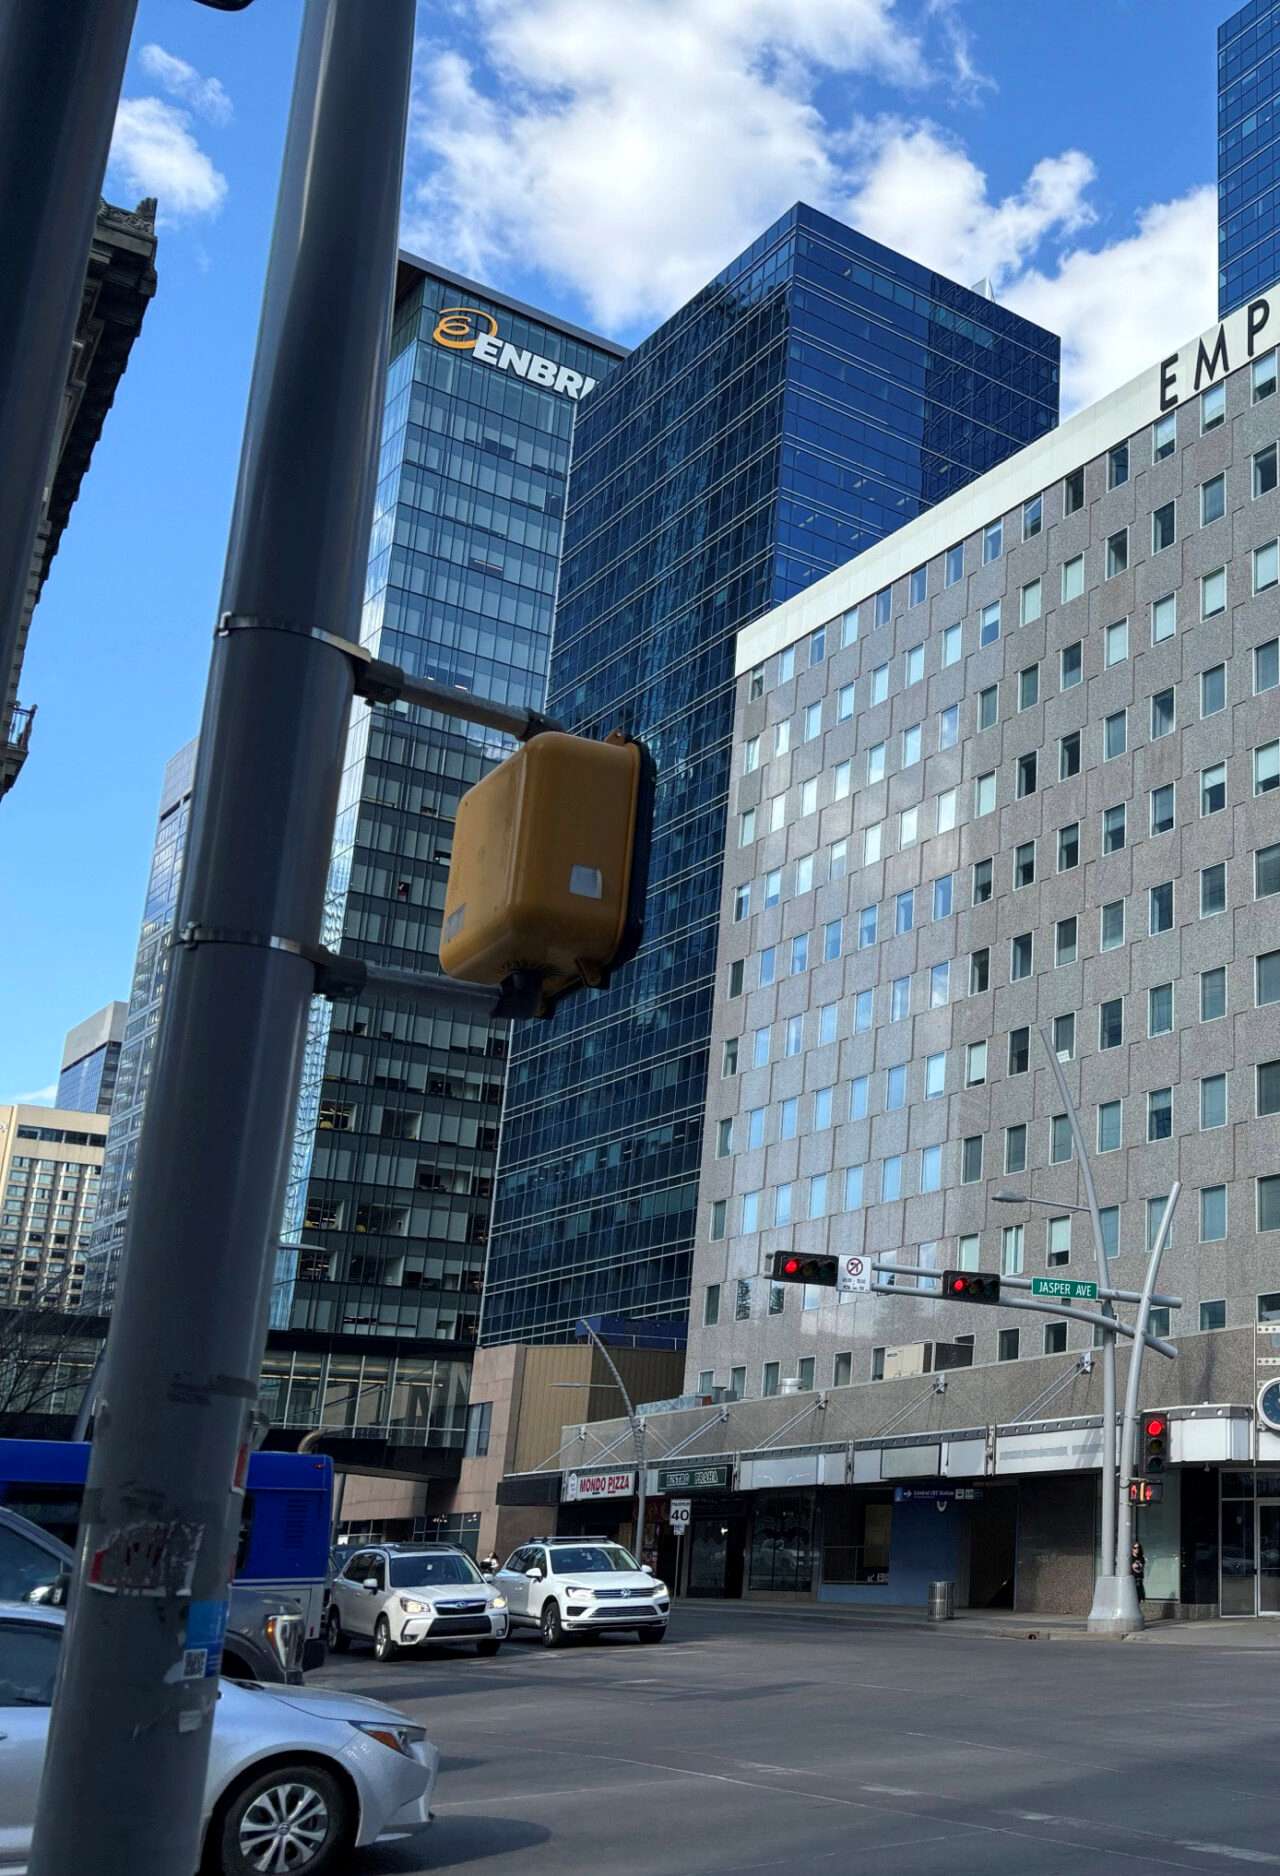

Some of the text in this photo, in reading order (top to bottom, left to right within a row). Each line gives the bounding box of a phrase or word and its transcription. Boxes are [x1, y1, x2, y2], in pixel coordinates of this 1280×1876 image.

[472, 333, 599, 400] ENBRI
[1039, 1282, 1092, 1297] JASPER AVE
[579, 1477, 606, 1493] MONDO
[607, 1475, 629, 1490] PIZZA
[672, 1509, 689, 1521] 40
